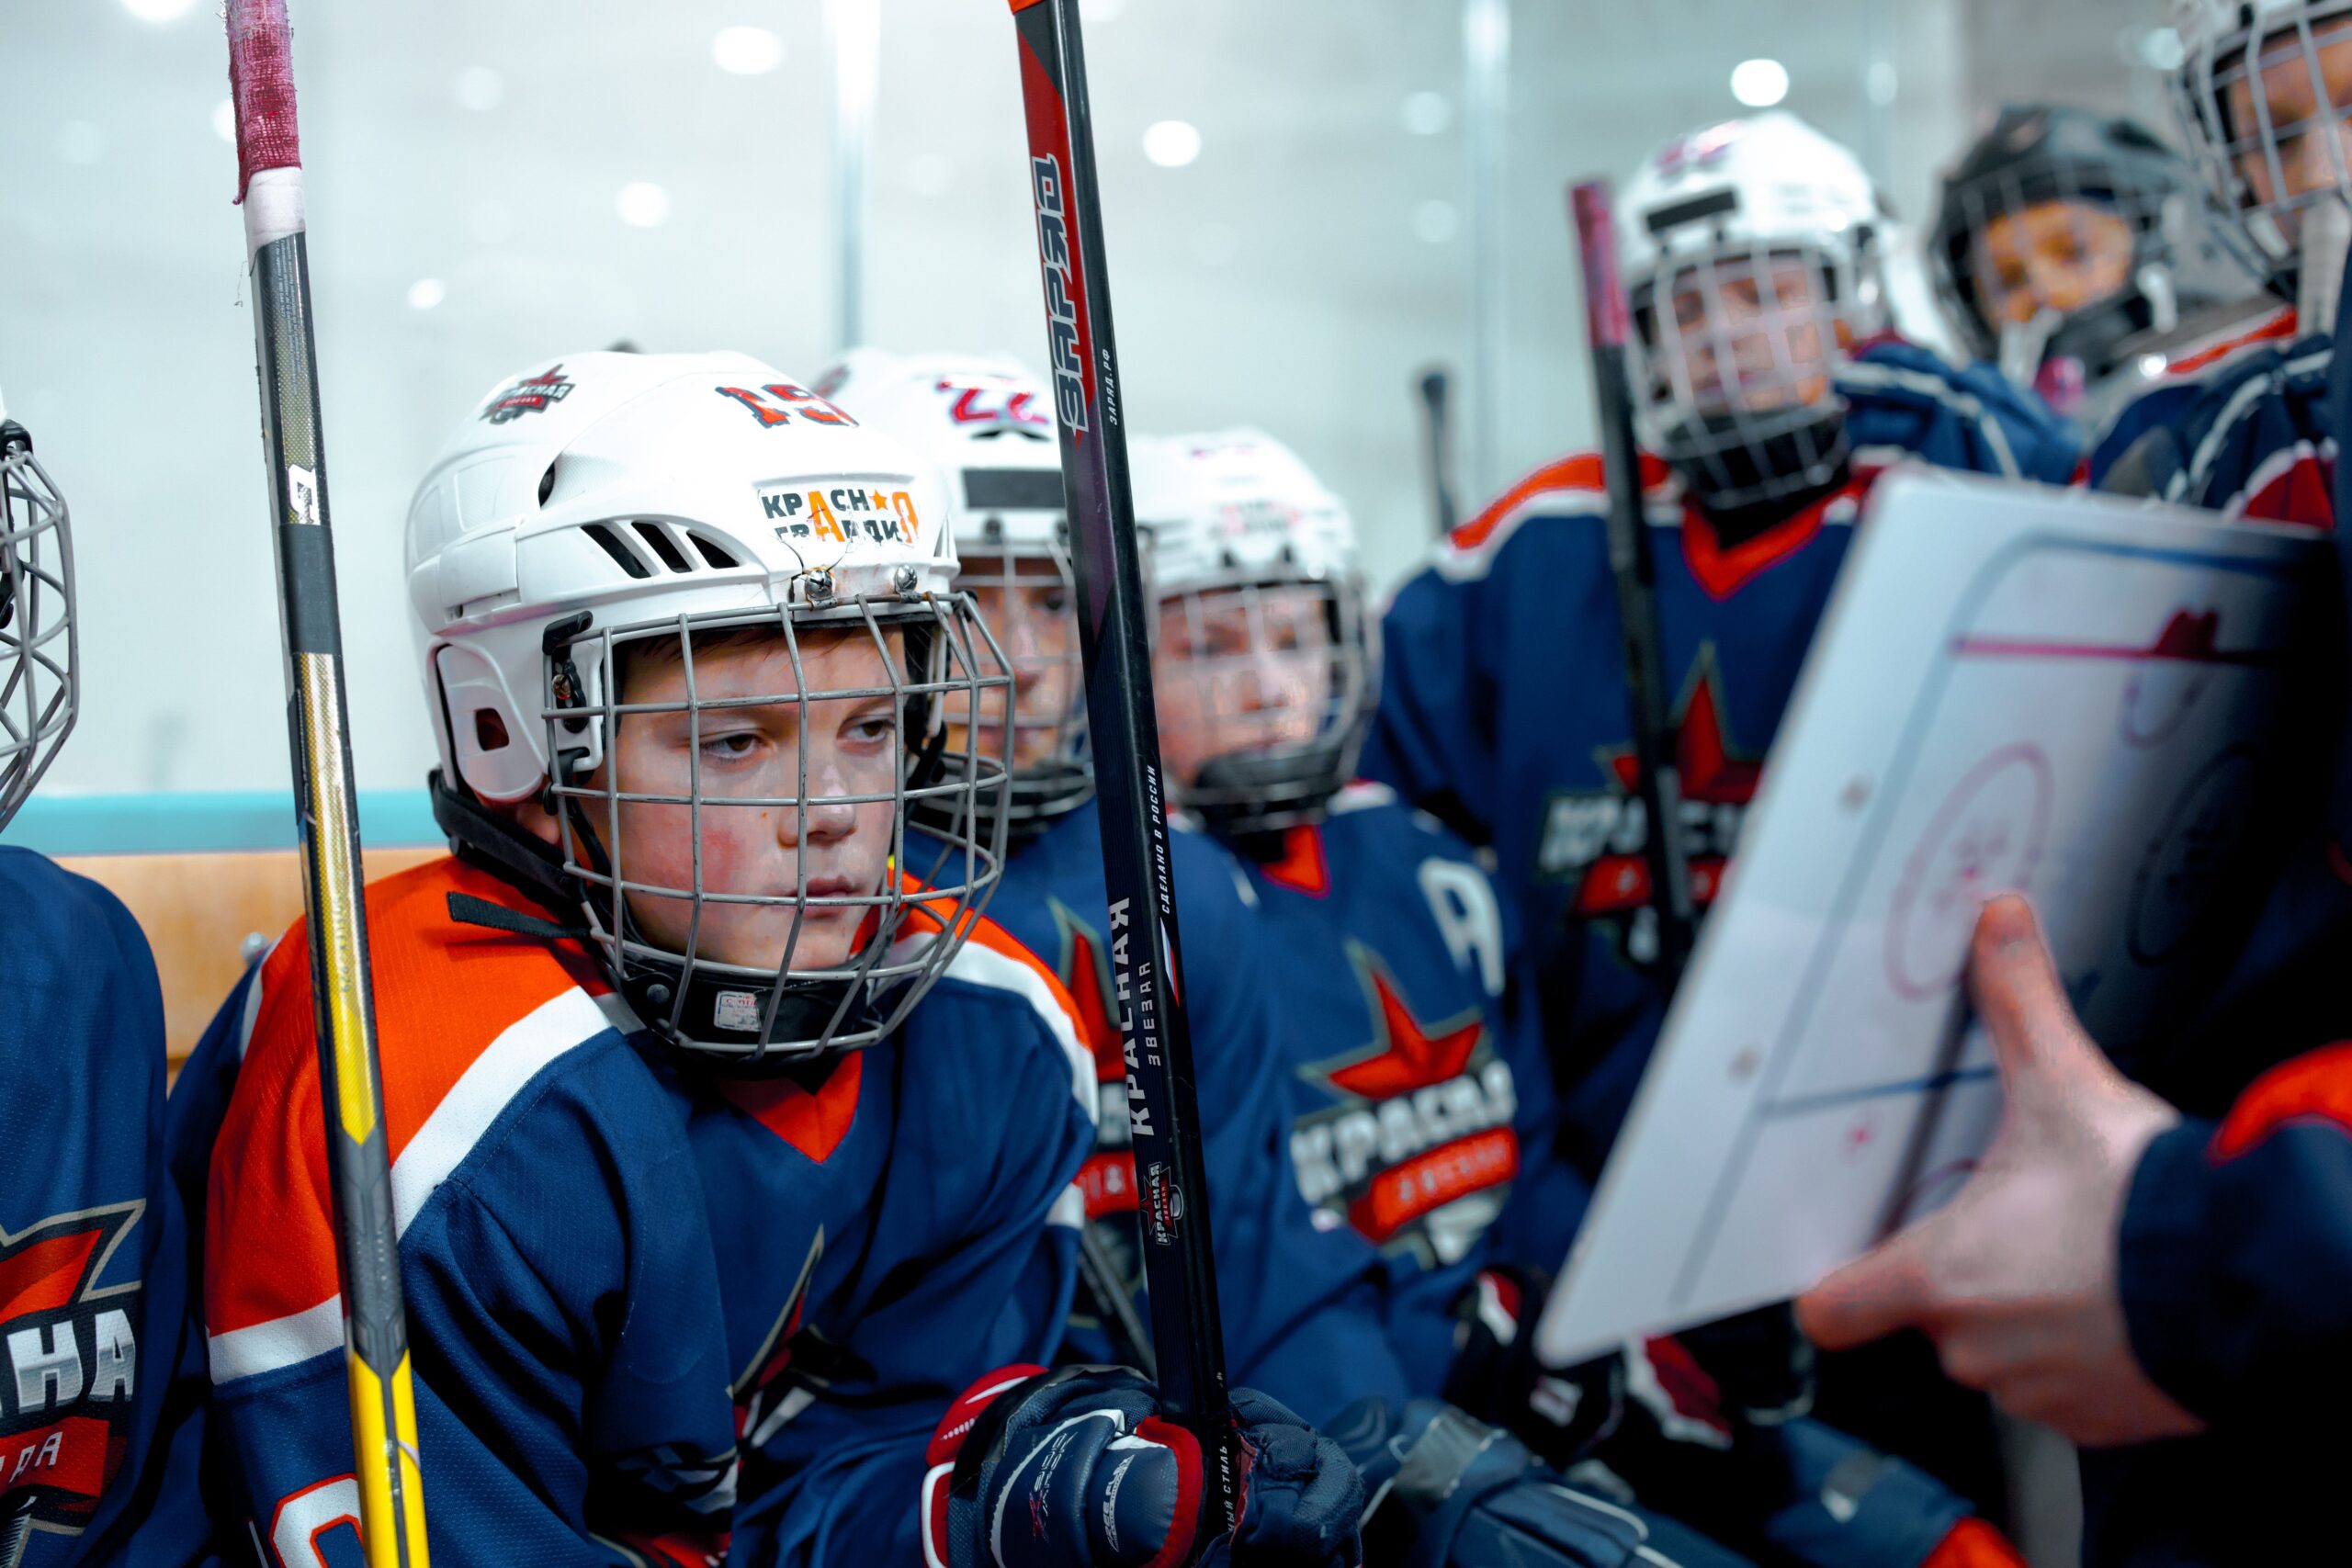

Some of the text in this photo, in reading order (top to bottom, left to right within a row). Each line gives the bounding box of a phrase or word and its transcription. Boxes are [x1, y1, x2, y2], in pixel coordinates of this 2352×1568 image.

[1032, 152, 1089, 434] ЗАРЯД
[1102, 349, 1118, 425] ЗАРЯД.РФ
[1147, 764, 1170, 915] СДЕЛАНО В РОССИИ
[1109, 897, 1155, 1136] КРАСНАЯ
[1149, 1164, 1168, 1244] КРАСНАЯ
[0, 1308, 136, 1414] НА
[1219, 1445, 1232, 1495] СТИЛЬ
